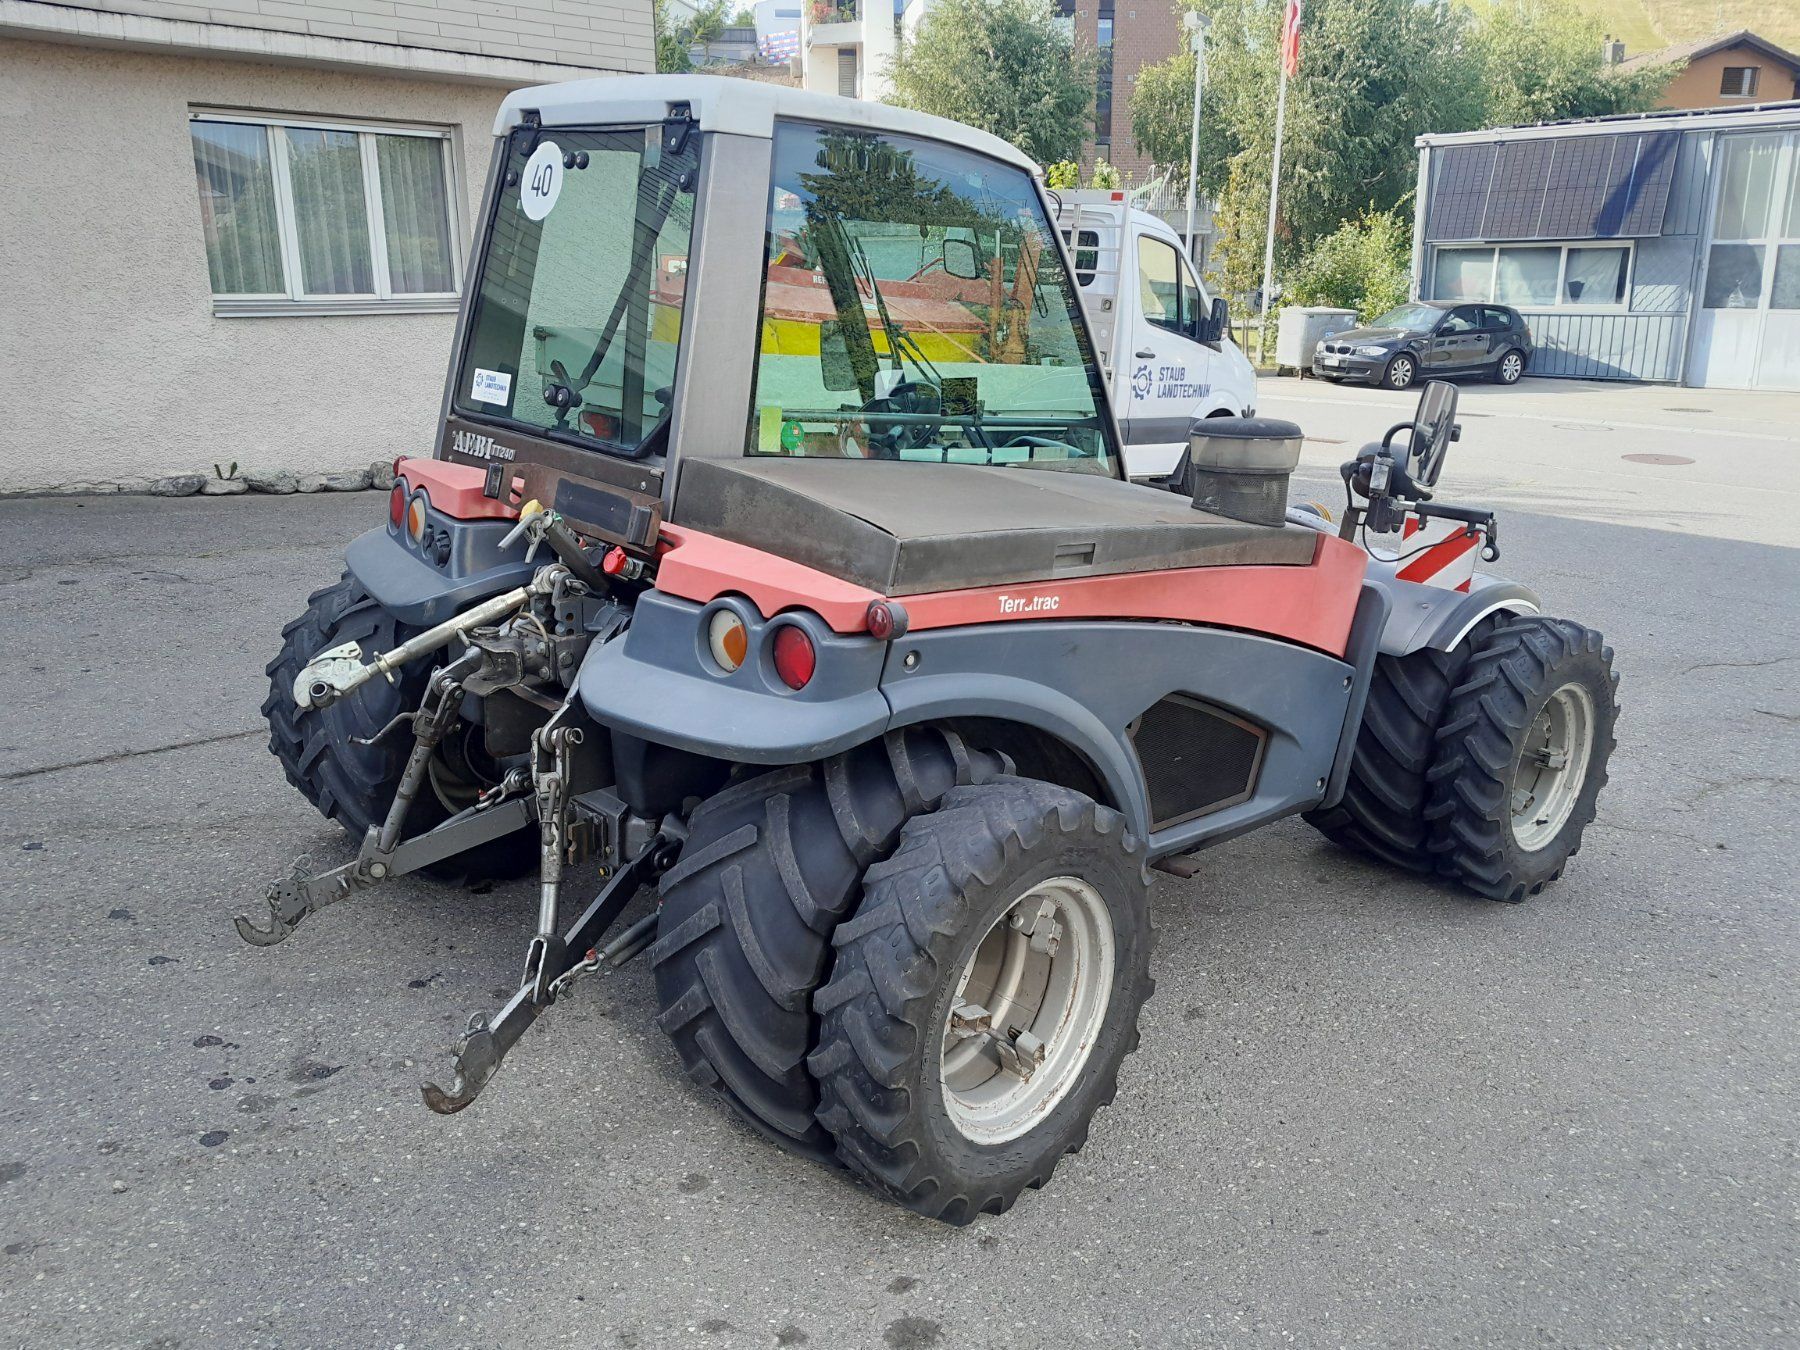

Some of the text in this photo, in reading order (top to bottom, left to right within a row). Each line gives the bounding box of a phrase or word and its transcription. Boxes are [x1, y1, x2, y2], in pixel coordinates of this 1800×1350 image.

[531, 164, 553, 198] 40
[1159, 366, 1186, 382] STAUB
[1157, 383, 1212, 399] LANDTECHNIK
[452, 430, 495, 460] AEBI
